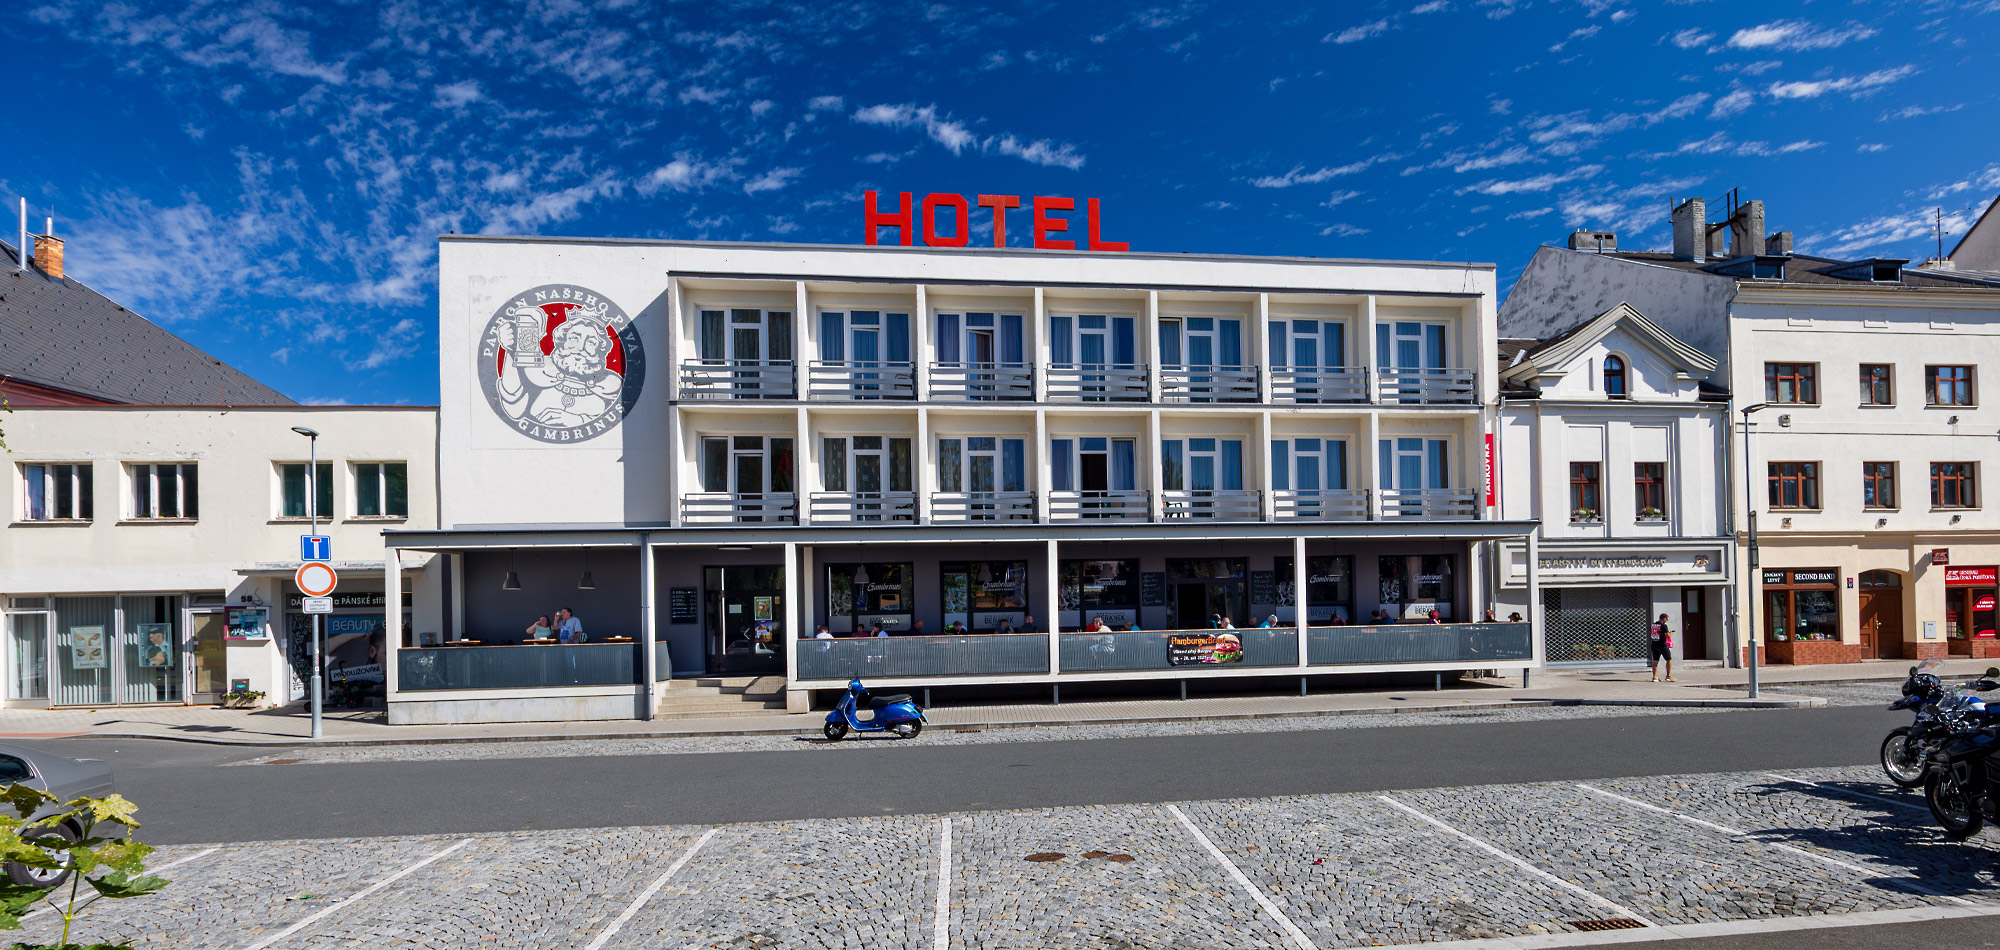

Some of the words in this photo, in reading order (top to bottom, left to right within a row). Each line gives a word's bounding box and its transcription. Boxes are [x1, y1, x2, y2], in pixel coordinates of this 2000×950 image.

[865, 190, 1129, 252] HOTEL
[483, 297, 528, 357] PATRON
[535, 288, 609, 315] NAŠEHO
[612, 314, 635, 354] PIVA
[518, 403, 625, 441] GAMBRINUS
[1539, 557, 1587, 568] EKAŘSTVÍ
[867, 582, 902, 591] Gambrinus
[341, 595, 371, 605] PÁNSKÉ
[332, 620, 376, 631] BEAUTY
